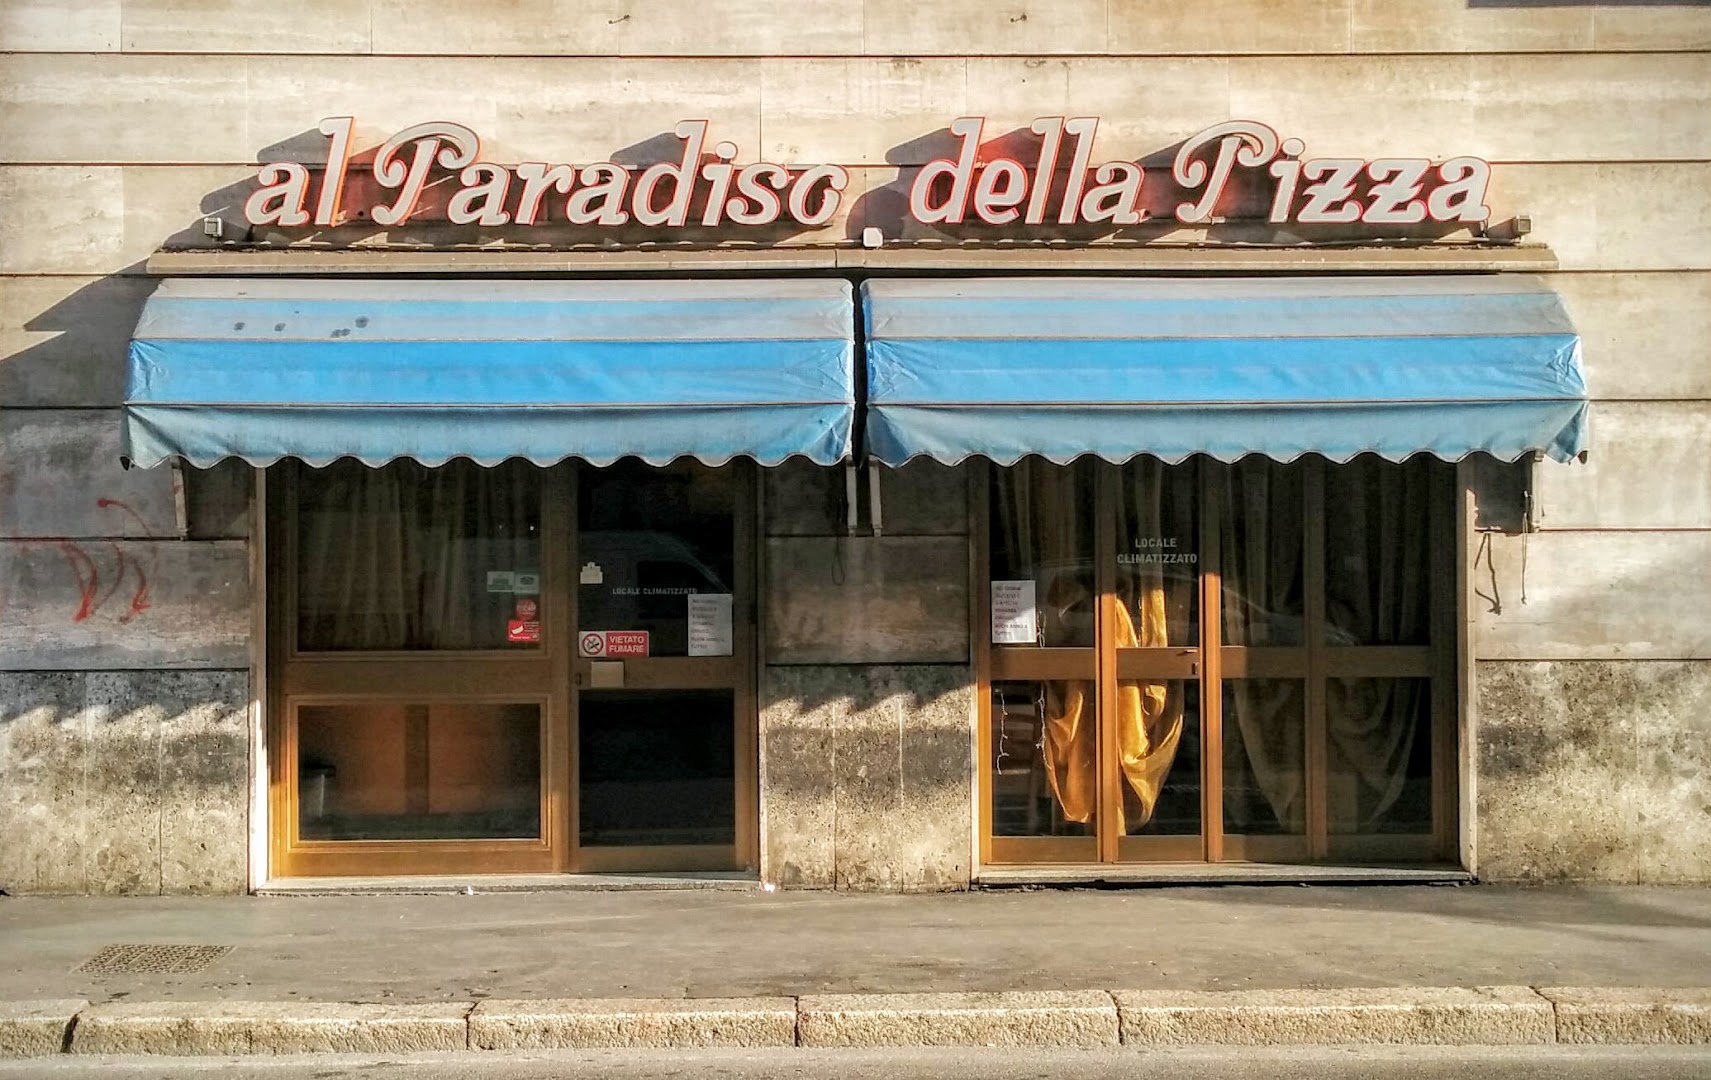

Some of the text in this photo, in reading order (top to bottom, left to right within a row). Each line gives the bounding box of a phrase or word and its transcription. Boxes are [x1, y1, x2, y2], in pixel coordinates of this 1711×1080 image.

[244, 115, 1493, 228] al Paradiso della Pizza
[1135, 537, 1177, 549] LOCALE
[1117, 553, 1198, 565] CLIMATIZZATO
[612, 587, 698, 596] LOCALE CLIMATIZZATO
[609, 635, 645, 645] VIETATO
[609, 644, 645, 654] FUMARE
